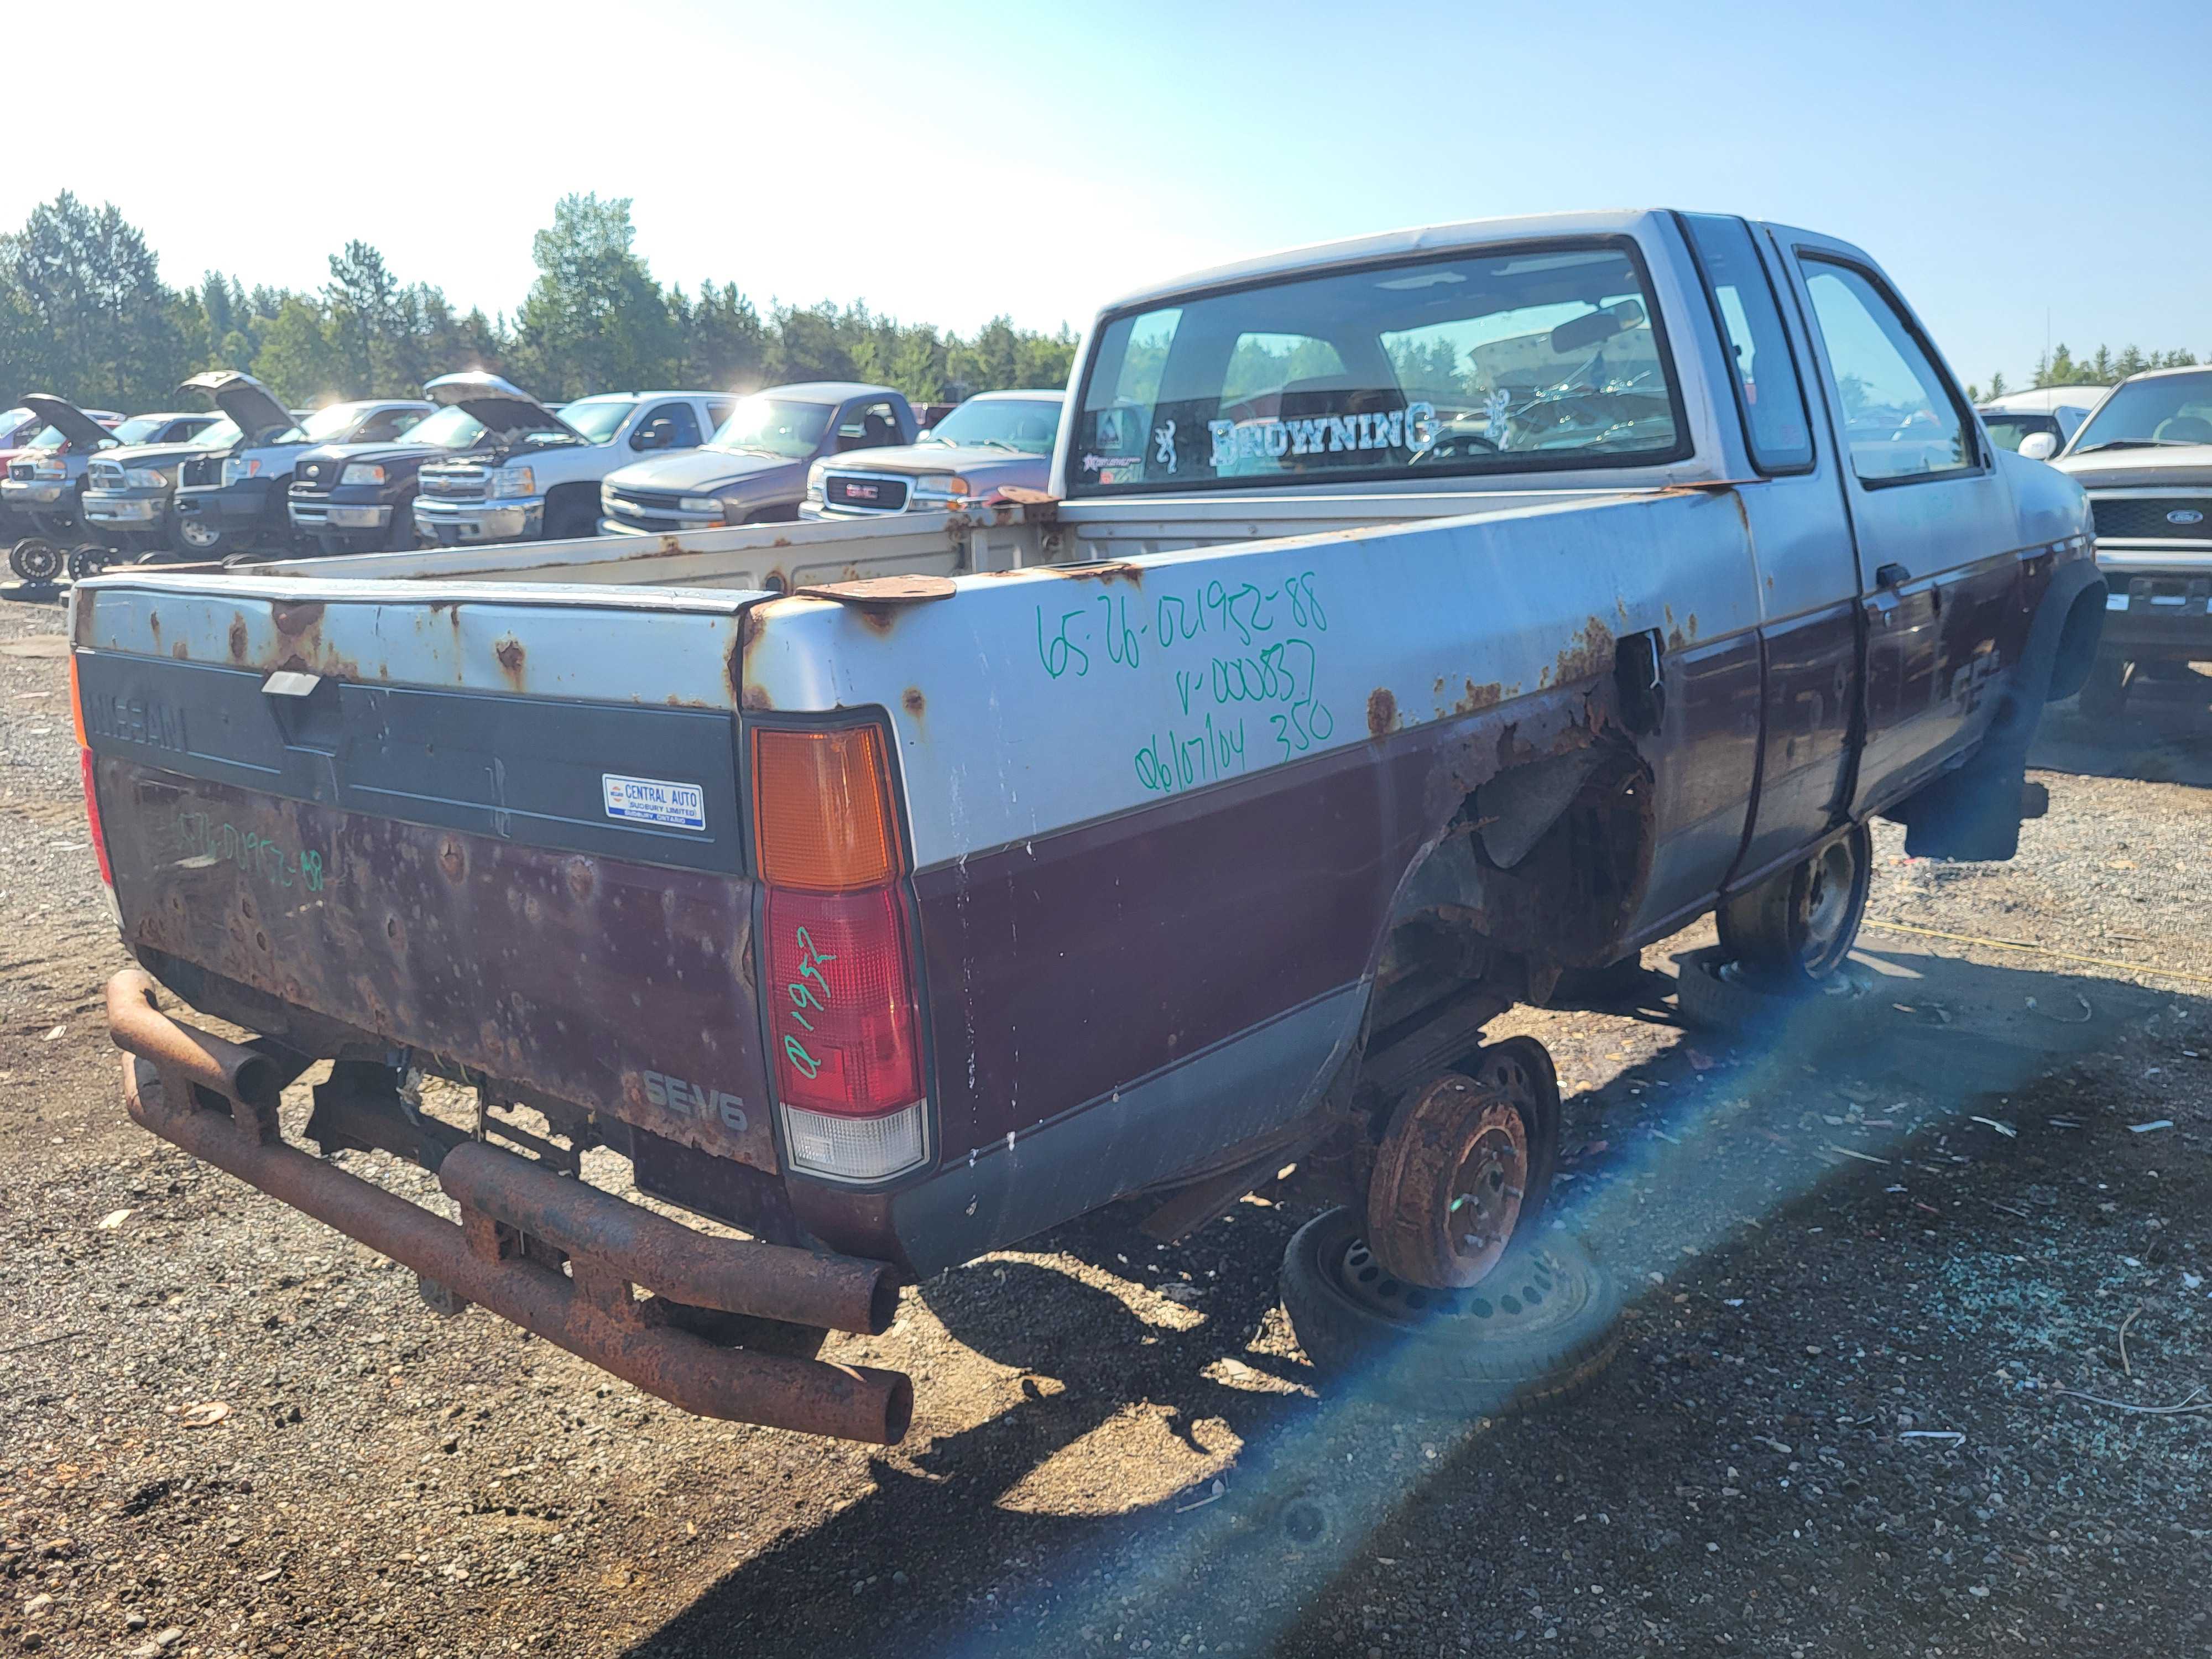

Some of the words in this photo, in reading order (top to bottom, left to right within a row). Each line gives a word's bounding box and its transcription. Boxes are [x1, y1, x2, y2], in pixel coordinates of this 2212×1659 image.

[1208, 401, 1441, 467] BROWNING
[1270, 699, 1333, 764] 350
[625, 784, 667, 804] CENTRAL
[672, 790, 697, 807] AUTO
